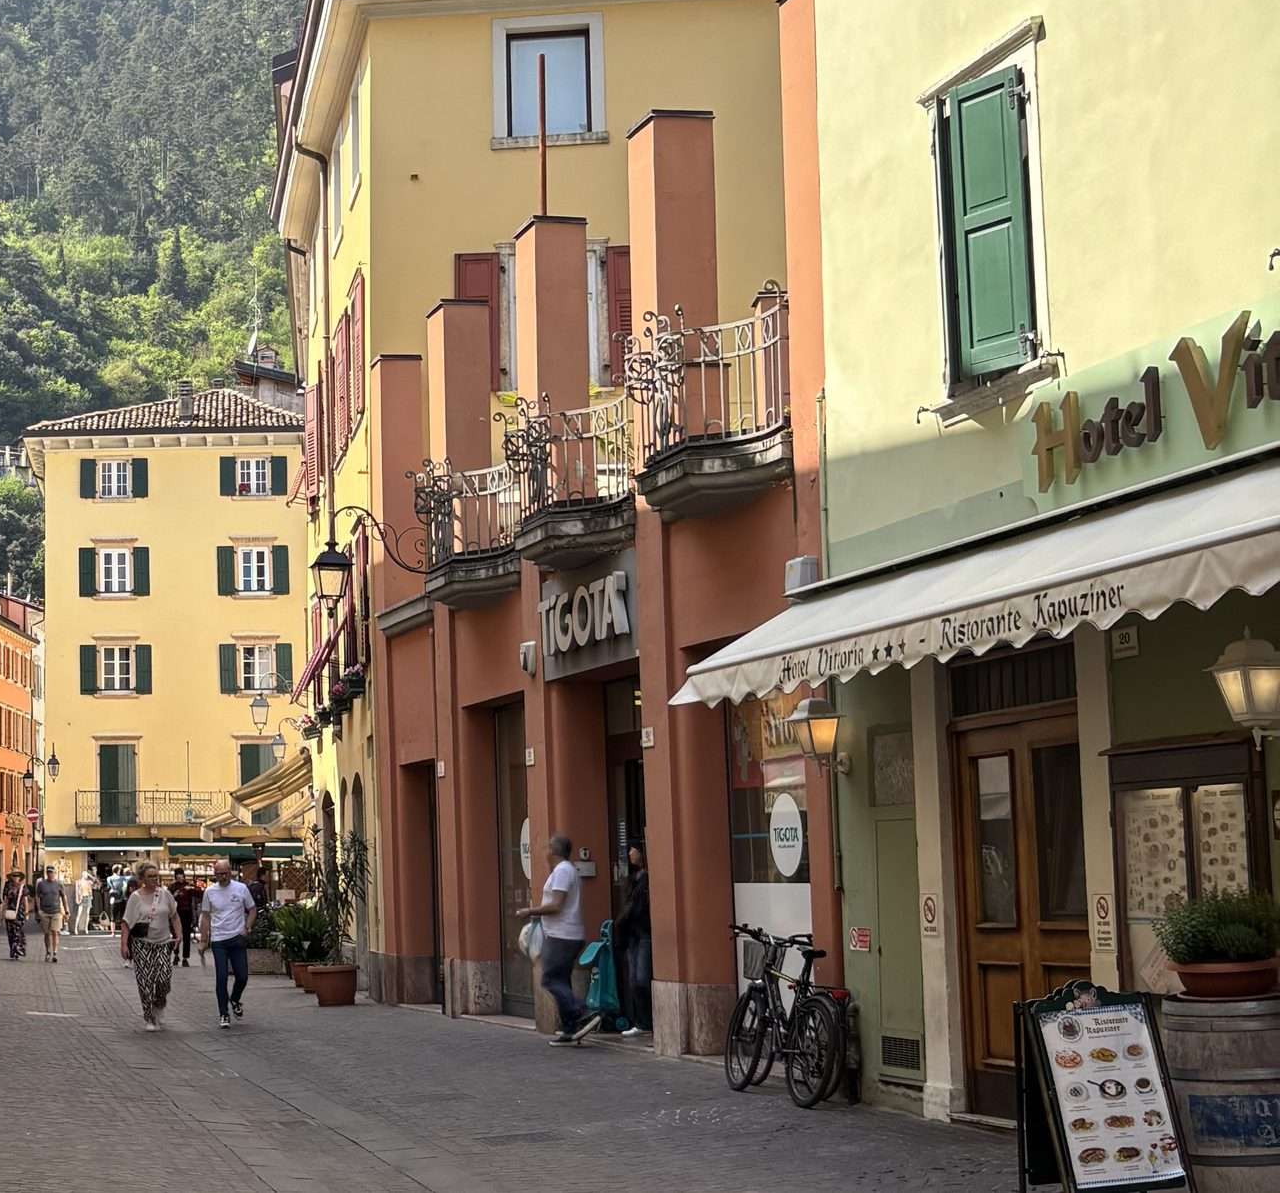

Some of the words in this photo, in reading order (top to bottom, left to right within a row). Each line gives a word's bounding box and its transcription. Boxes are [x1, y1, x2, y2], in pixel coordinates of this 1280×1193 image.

[1031, 366, 1163, 494] Hotel
[779, 652, 812, 684] Hotel
[939, 608, 1022, 650] Ristorante
[1032, 583, 1124, 635] Kapuziner
[1119, 631, 1130, 645] 20
